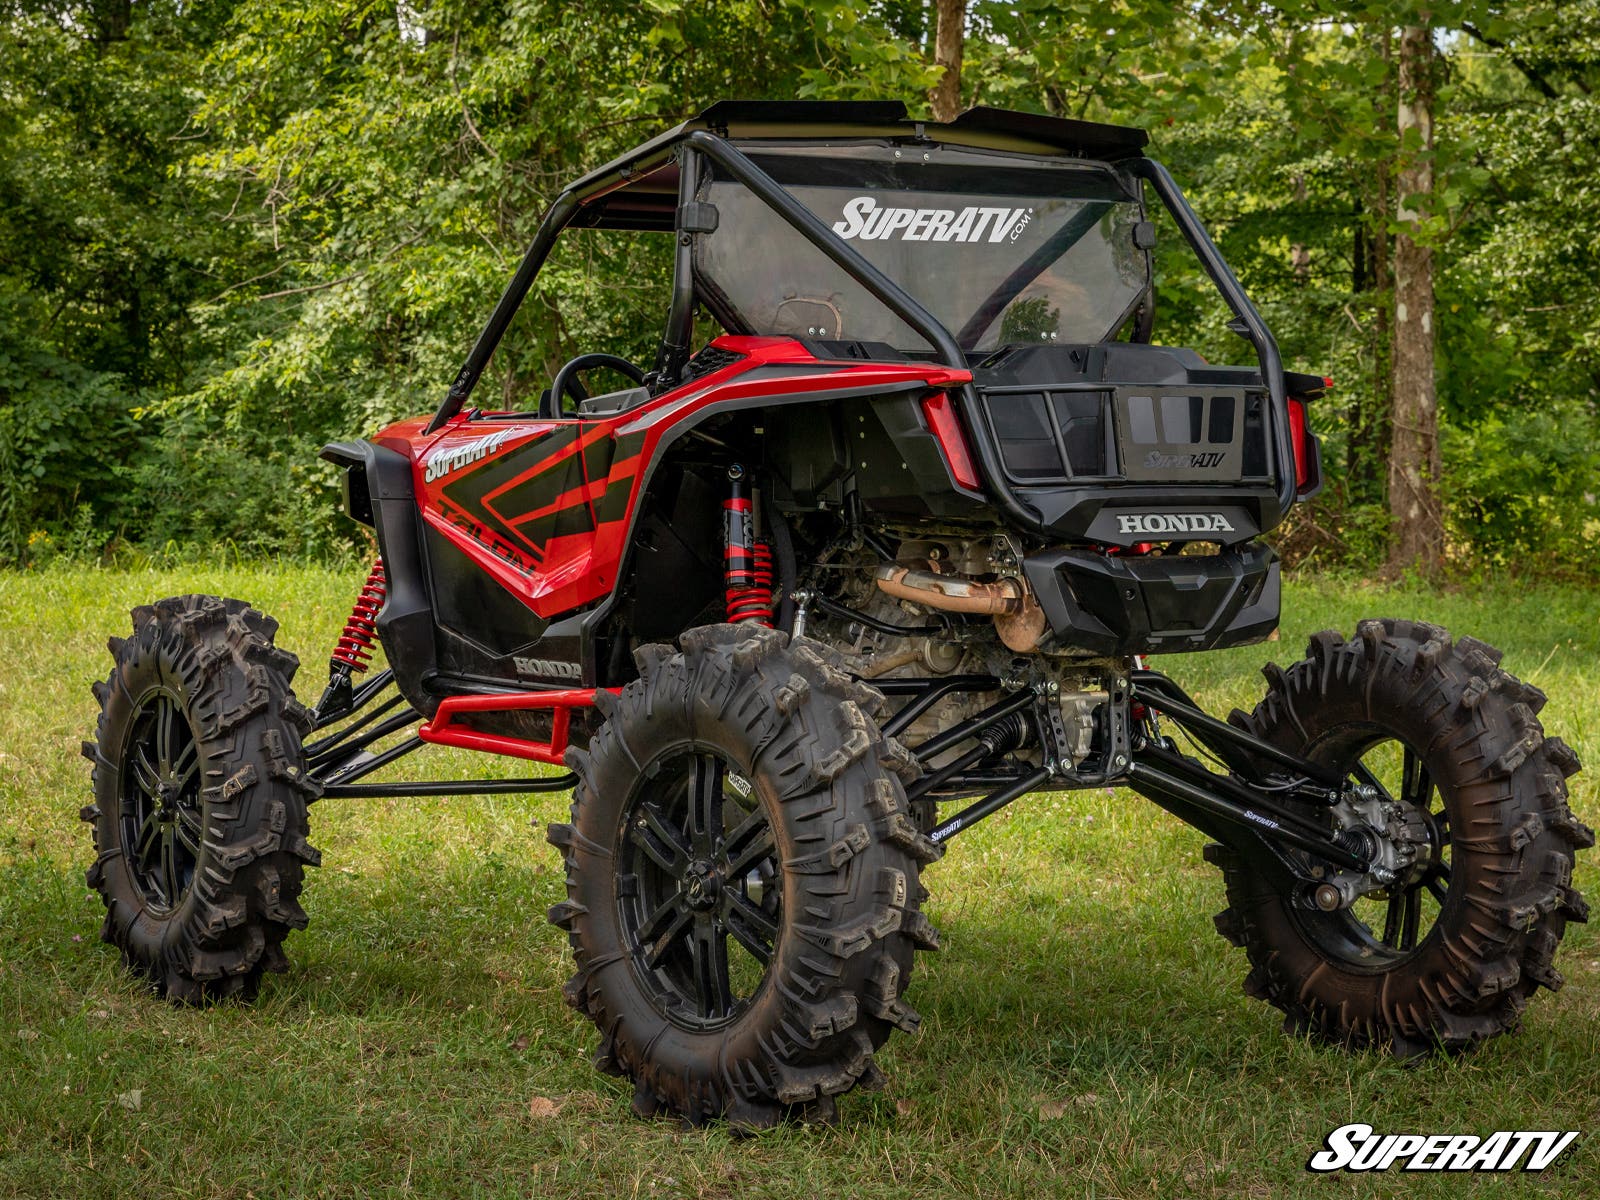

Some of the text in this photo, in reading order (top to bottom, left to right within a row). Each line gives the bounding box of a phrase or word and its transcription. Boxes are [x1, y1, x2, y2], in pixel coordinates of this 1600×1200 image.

[832, 197, 1025, 243] SUPERATV
[1116, 513, 1235, 533] HONDA
[512, 656, 583, 679] HONDA
